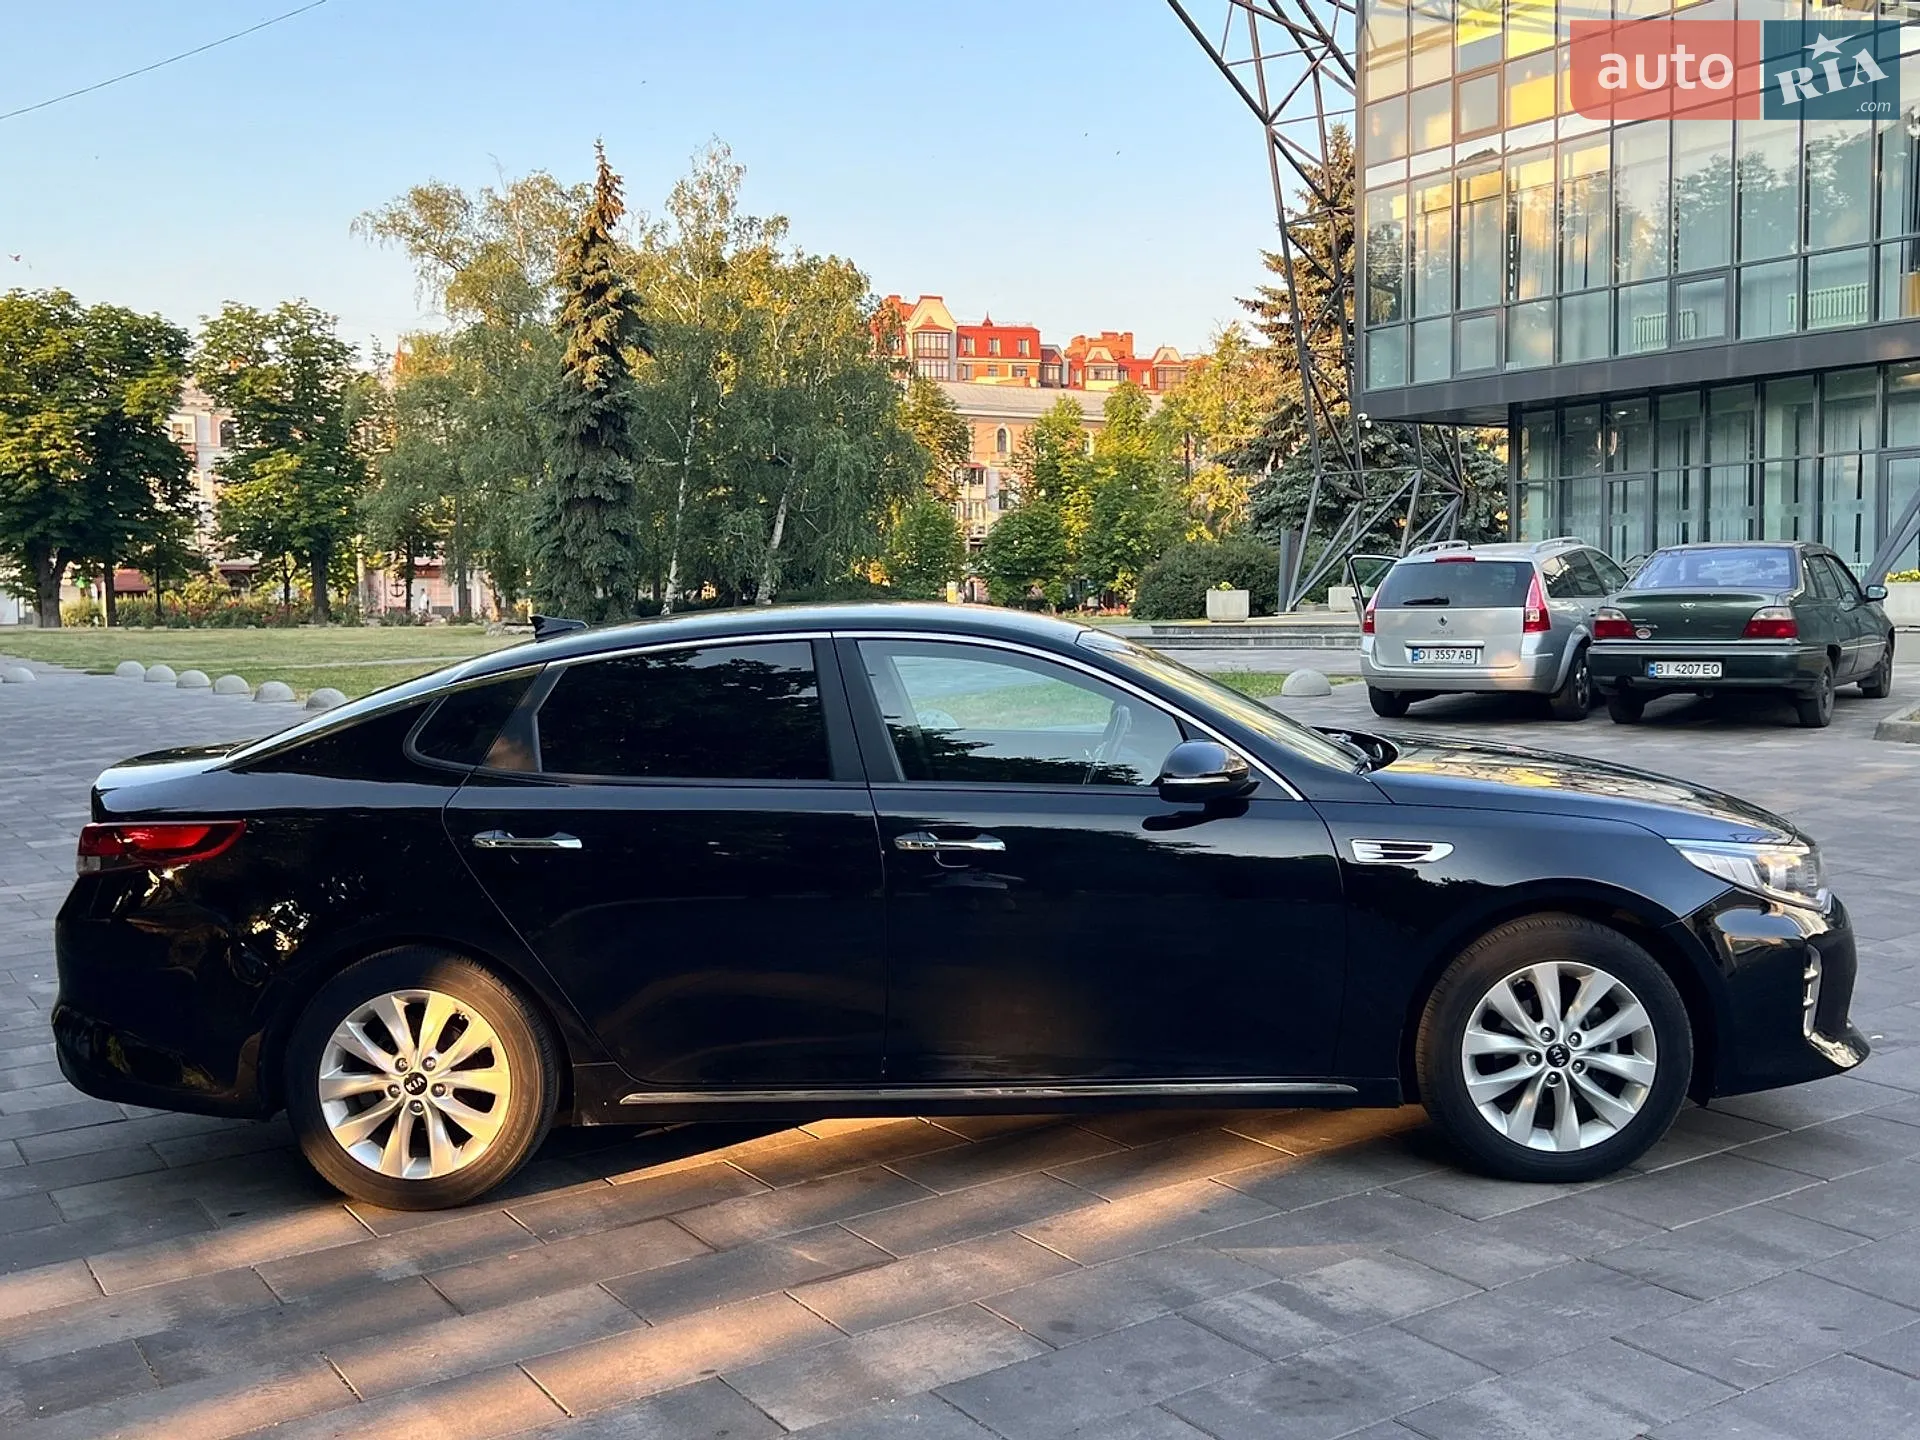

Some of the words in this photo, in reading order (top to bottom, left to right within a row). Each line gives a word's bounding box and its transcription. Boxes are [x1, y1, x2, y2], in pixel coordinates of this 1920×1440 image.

[1435, 650, 1456, 660] 3557
[1459, 650, 1473, 660] AB
[1656, 664, 1670, 674] BI
[1674, 664, 1700, 674] 4207
[1702, 664, 1720, 674] EO
[405, 1077, 425, 1091] KIA
